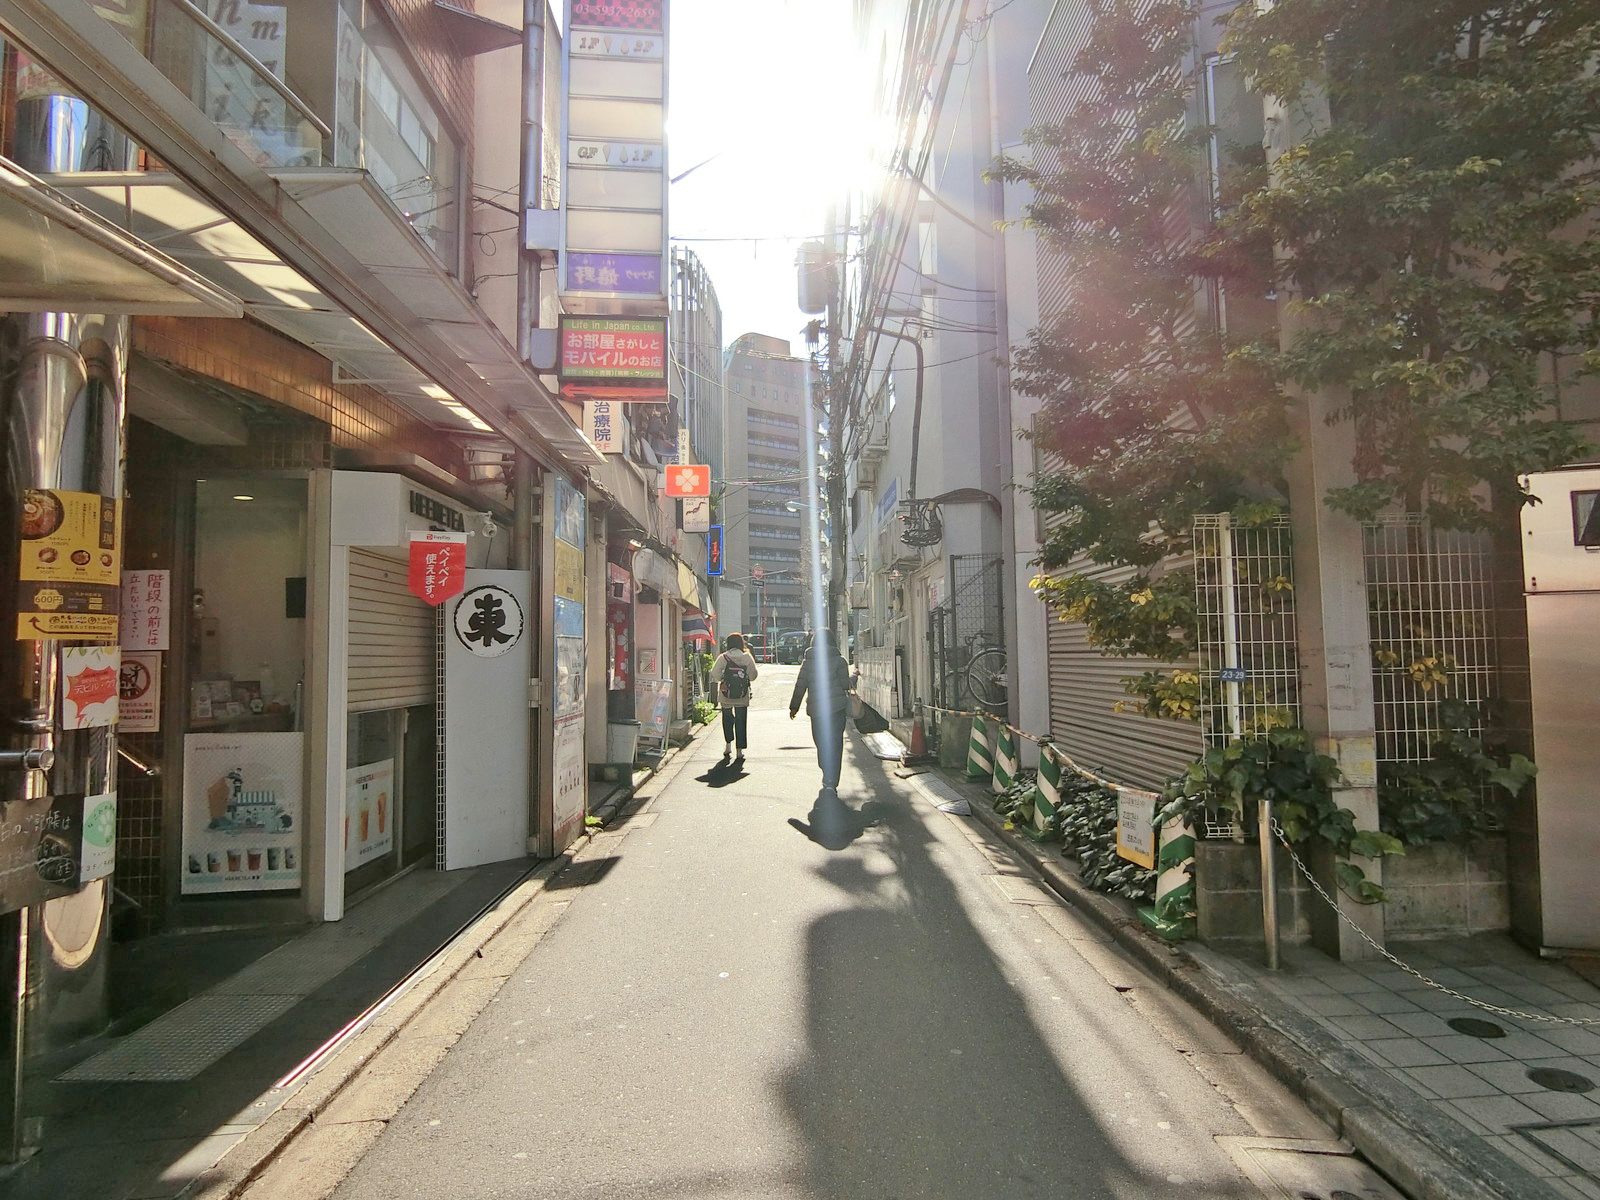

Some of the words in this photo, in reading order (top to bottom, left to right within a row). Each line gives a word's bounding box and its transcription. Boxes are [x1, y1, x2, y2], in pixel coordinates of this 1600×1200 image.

[579, 37, 600, 50] 1F
[571, 321, 588, 330] Life
[592, 321, 600, 330] in
[604, 322, 630, 332] Japan
[567, 333, 660, 350] お部屋さがしと
[565, 350, 662, 367] モバイルのお店
[593, 401, 612, 442] 治療院
[438, 546, 451, 587] ペイペイ
[424, 553, 438, 599] 使えます。
[35, 595, 63, 604] 600円
[145, 574, 165, 646] 階段の前には
[1222, 670, 1245, 680] 23-29
